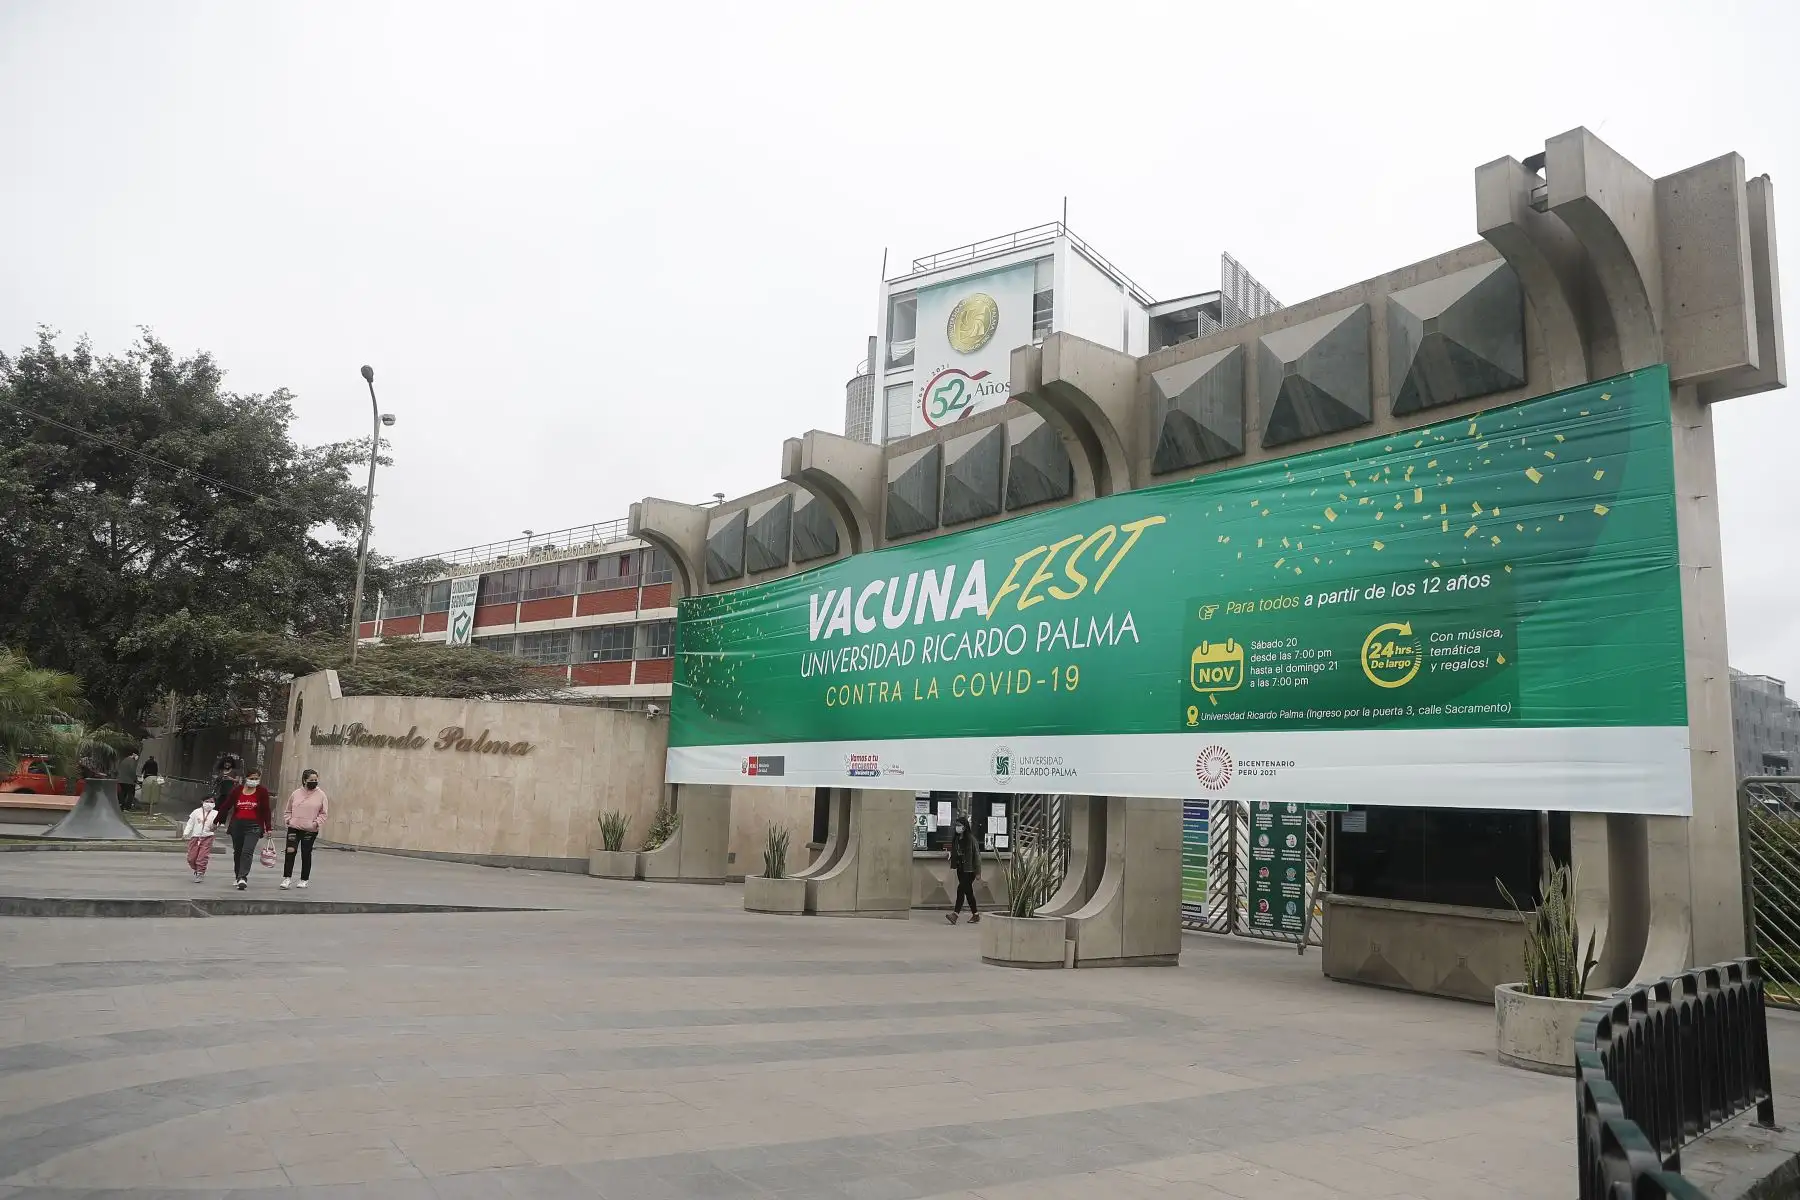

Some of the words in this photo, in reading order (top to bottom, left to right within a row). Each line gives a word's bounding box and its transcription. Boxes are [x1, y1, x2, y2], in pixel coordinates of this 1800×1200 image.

[930, 379, 971, 418] 52
[974, 381, 1011, 397] Años
[1226, 600, 1254, 615] Para
[1259, 594, 1299, 610] todos
[1304, 595, 1313, 607] a
[1317, 588, 1358, 609] partir
[1365, 584, 1385, 600] de
[1391, 580, 1416, 597] los
[1422, 577, 1440, 593] 12
[1446, 573, 1491, 592] años
[1430, 632, 1454, 642] Con
[1457, 628, 1504, 641] música,
[801, 639, 915, 678] UNIVERSIDAD
[922, 623, 1027, 664] RICARDO
[1036, 610, 1140, 653] PALMA
[1250, 640, 1284, 650] Sábado
[1286, 637, 1298, 647] 20
[1369, 641, 1394, 659] 24
[1250, 652, 1277, 663] desde
[1279, 650, 1292, 660] las
[1294, 649, 1315, 660] 7:00
[1317, 650, 1332, 660] pm
[1430, 645, 1481, 657] temática
[1250, 665, 1273, 675] hasta
[1275, 664, 1283, 674] el
[1285, 662, 1325, 674] domingo
[1328, 661, 1339, 671] 21
[1371, 660, 1386, 669] De
[1386, 659, 1411, 669] largo
[1430, 662, 1438, 673] y
[1440, 657, 1489, 672] regalos!
[1199, 666, 1235, 683] NOV
[826, 680, 902, 707] CONTRA
[914, 677, 939, 701] LA
[952, 665, 1080, 698] COVID-19
[1250, 680, 1255, 688] a
[1257, 677, 1270, 687] las
[1272, 677, 1292, 687] 7:00
[1294, 677, 1309, 687] pm
[1200, 711, 1246, 721] Universidad
[1247, 710, 1278, 720] Ricardo
[1279, 709, 1304, 719] Palma
[1344, 709, 1360, 719] por
[1362, 706, 1370, 717] la
[1372, 707, 1403, 719] puerta
[1405, 705, 1415, 717] 3,
[1418, 704, 1442, 715] calle
[1444, 702, 1512, 715] Sacramento)
[433, 725, 537, 755] Palma
[850, 754, 867, 762] Vamos
[872, 754, 879, 762] tu
[1019, 756, 1064, 766] UNIVERSIDAD
[851, 762, 878, 770] encuentro
[1019, 767, 1050, 776] RICARDO
[1051, 768, 1078, 777] PALMA
[1238, 768, 1258, 776] PERÚ
